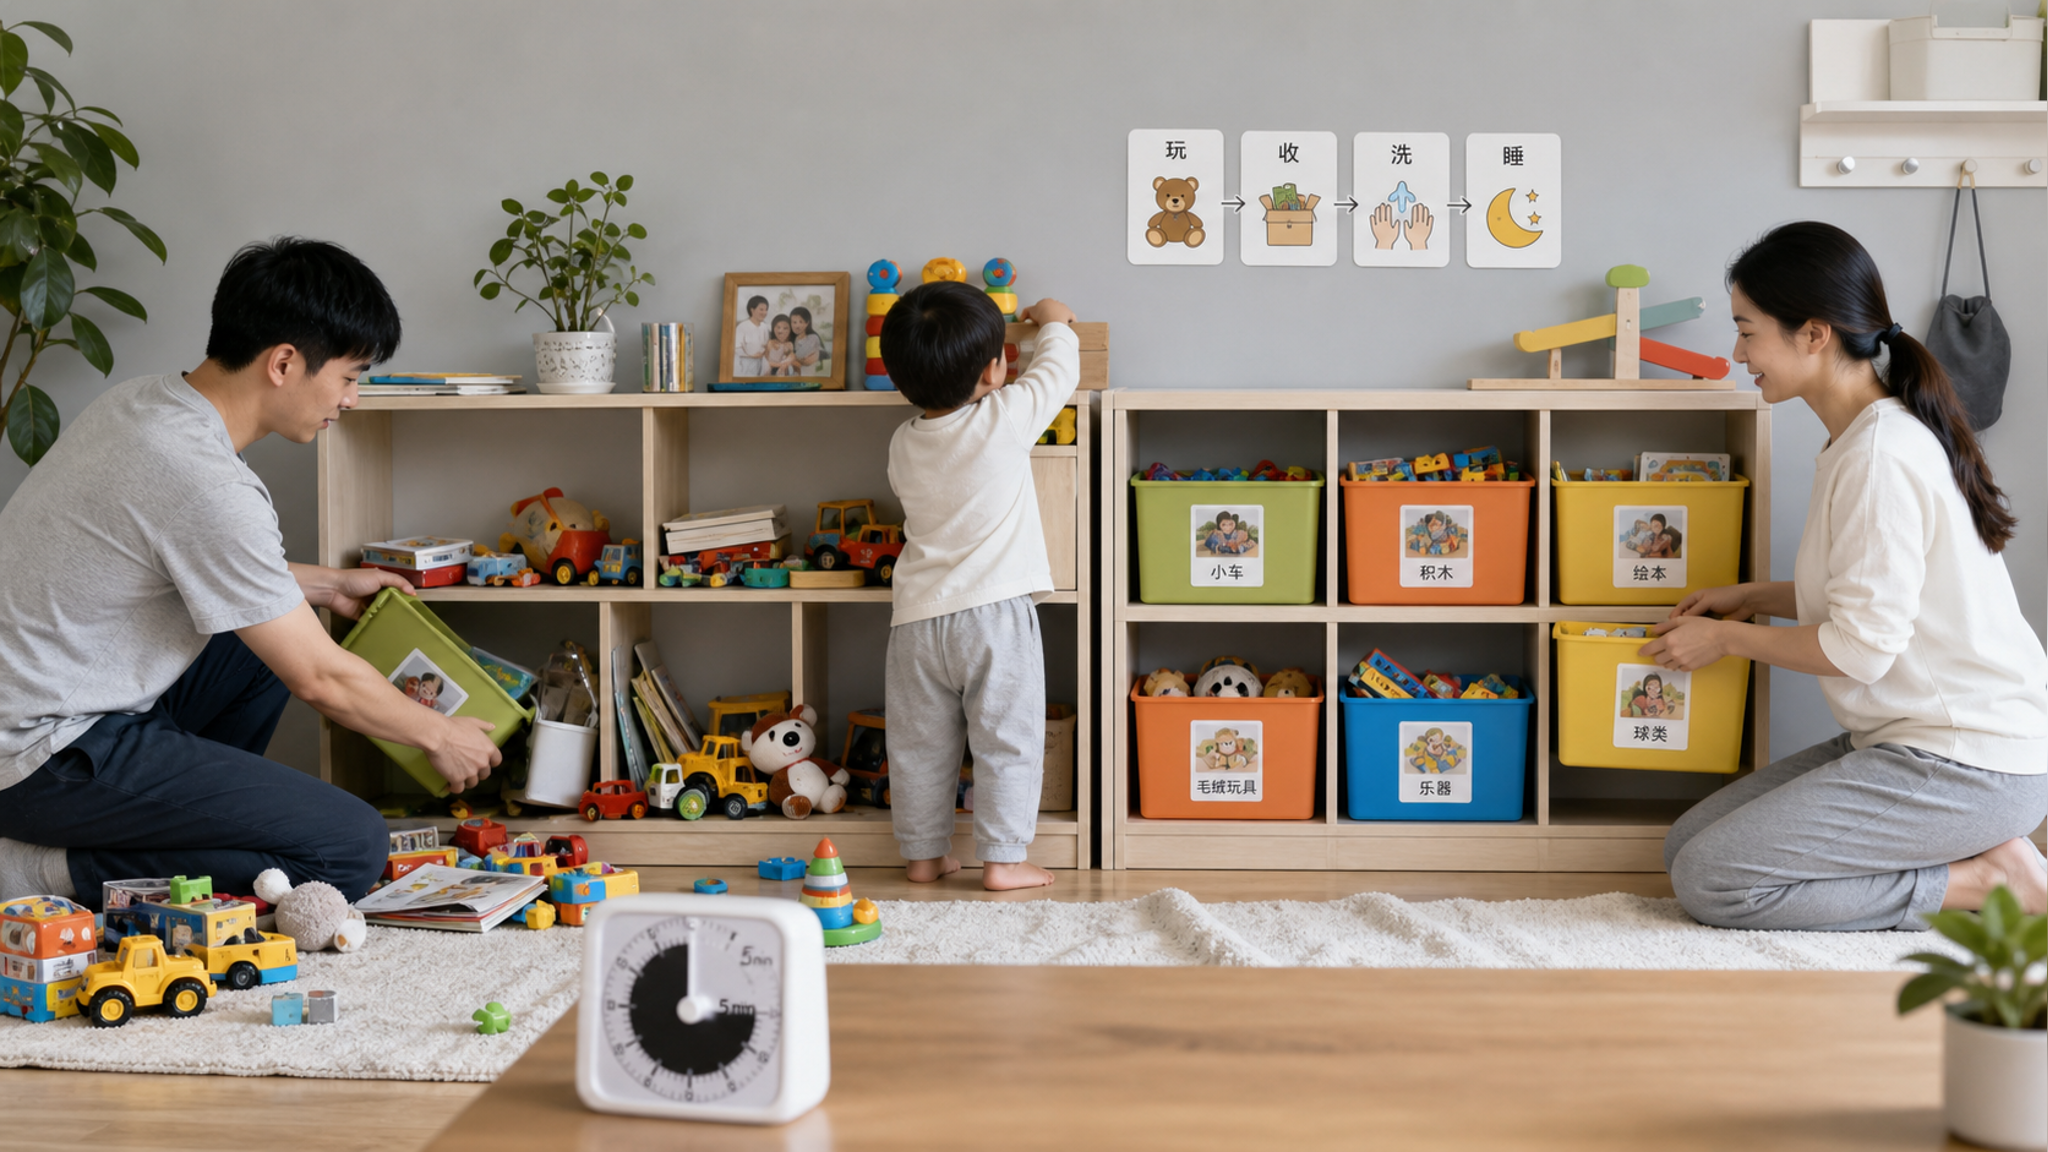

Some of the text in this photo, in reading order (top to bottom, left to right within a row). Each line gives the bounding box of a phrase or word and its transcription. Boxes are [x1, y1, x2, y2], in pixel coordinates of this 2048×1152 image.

[1165, 140, 1187, 161] 玩
[1278, 142, 1300, 163] 收
[1390, 144, 1412, 165] 洗
[1502, 145, 1524, 166] 睡
[1211, 563, 1243, 580] 小车
[1419, 563, 1454, 580] 积木
[1633, 565, 1668, 582] 绘本
[1633, 725, 1668, 743] 球类
[1196, 780, 1258, 796] 毛绒玩具
[1419, 780, 1452, 797] 乐器
